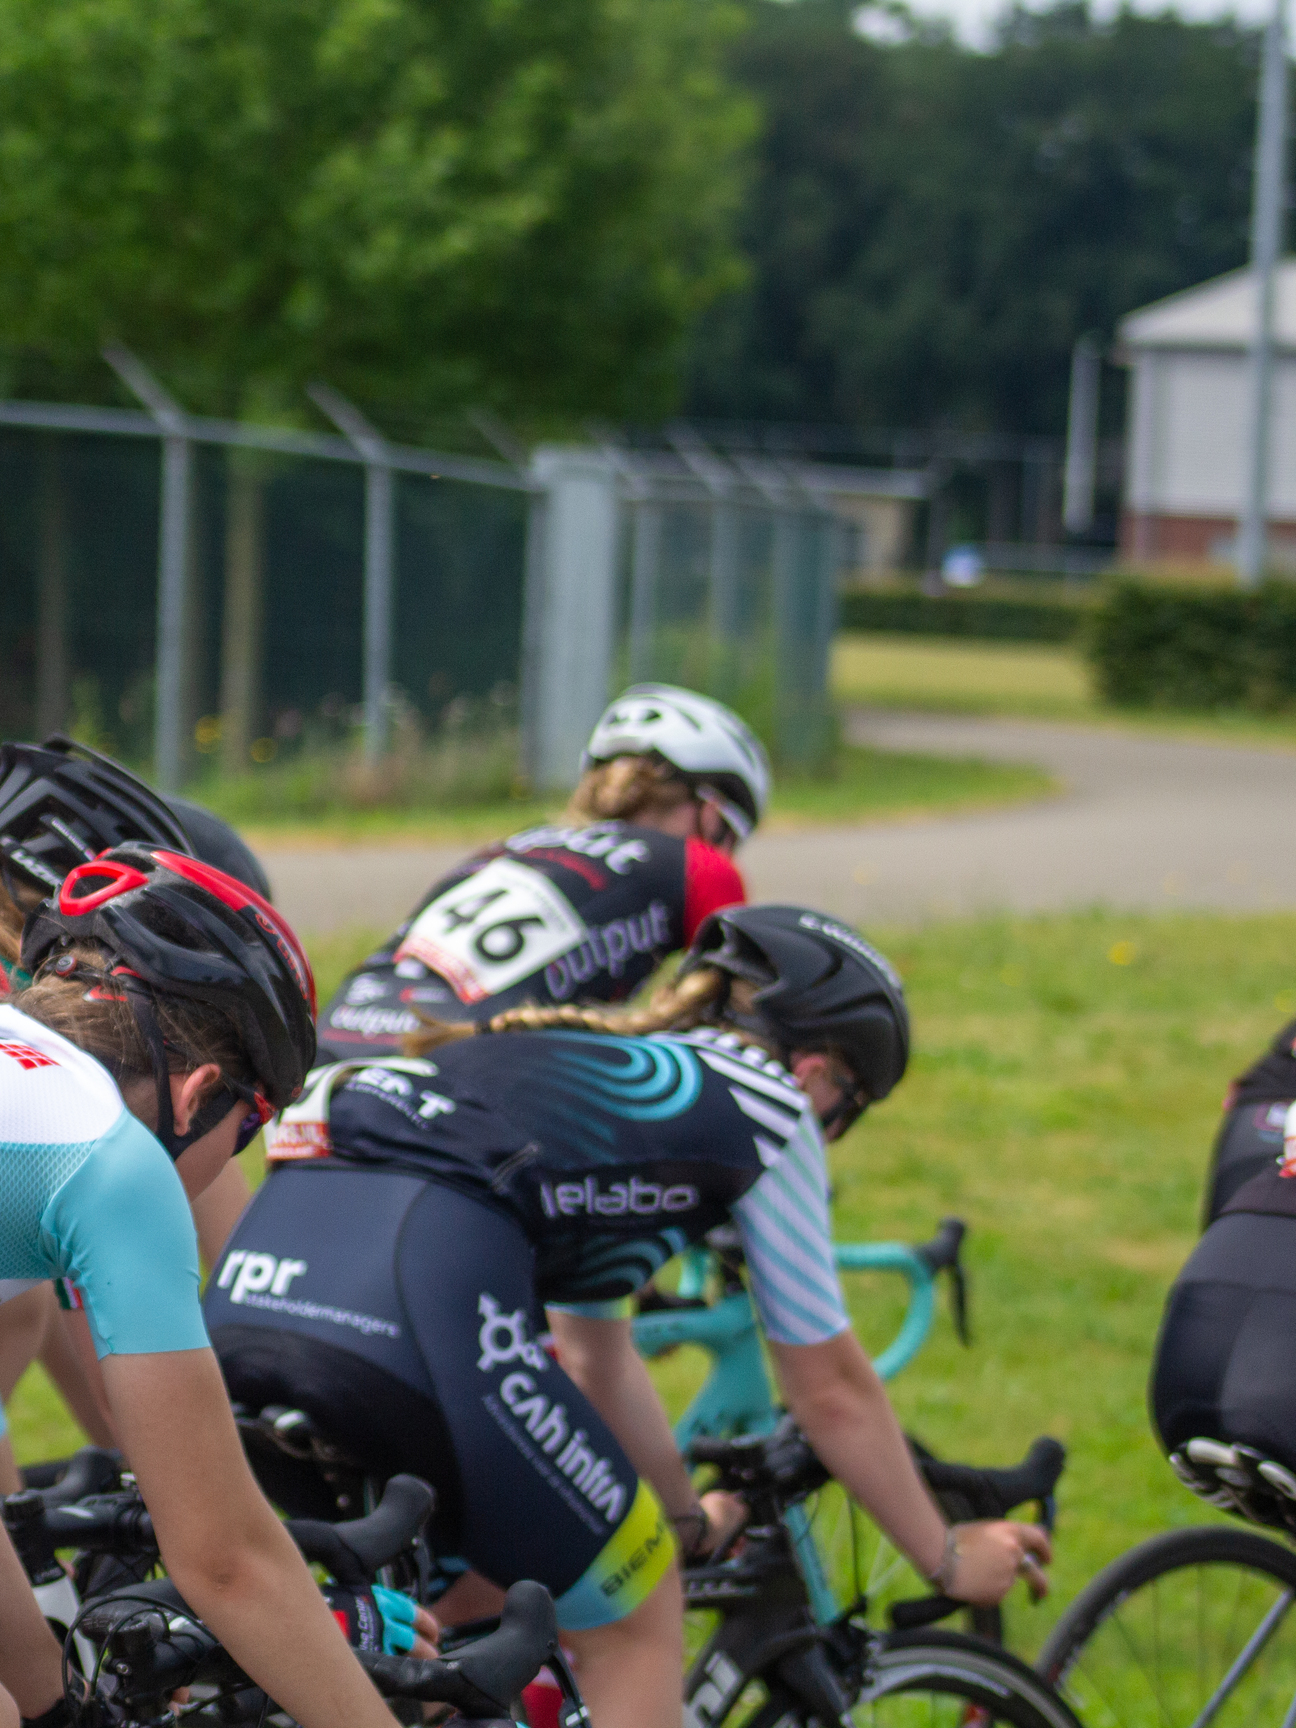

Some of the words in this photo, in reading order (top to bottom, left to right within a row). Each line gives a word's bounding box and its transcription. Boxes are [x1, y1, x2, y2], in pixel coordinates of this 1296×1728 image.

[442, 889, 547, 962] 46
[544, 902, 672, 998] output
[217, 1249, 307, 1304] rpr
